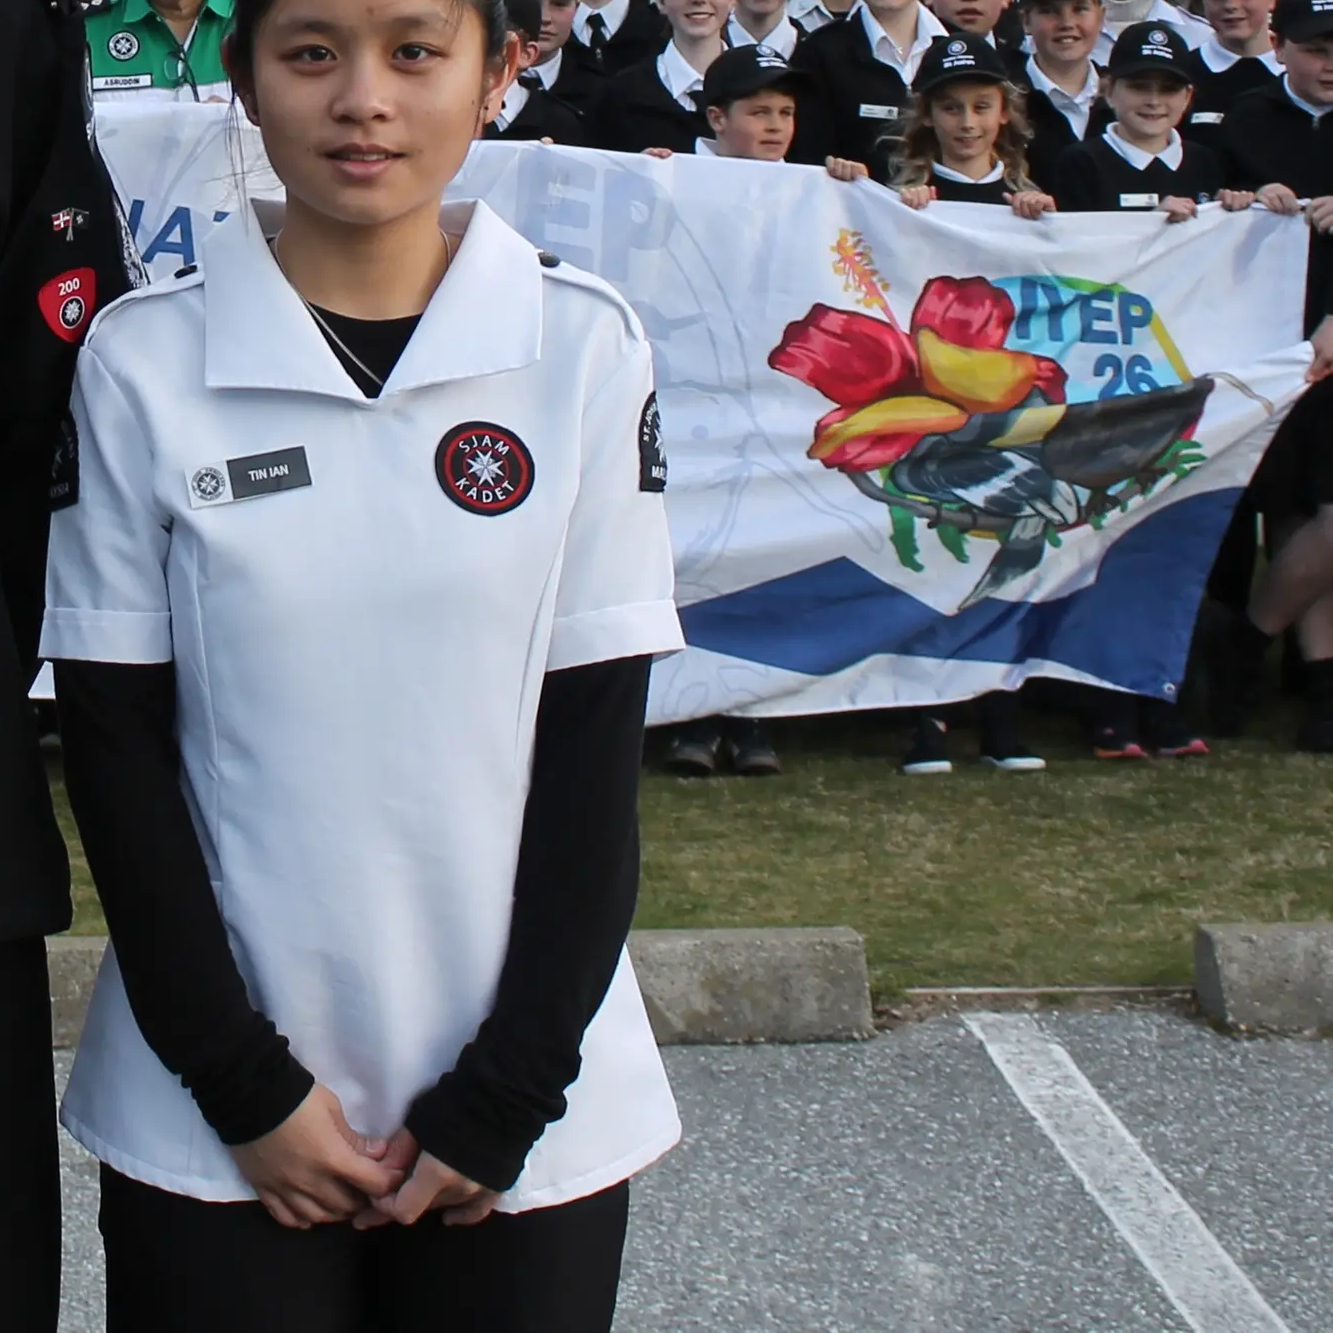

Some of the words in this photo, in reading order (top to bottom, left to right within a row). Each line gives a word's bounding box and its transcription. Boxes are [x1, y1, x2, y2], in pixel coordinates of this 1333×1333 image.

[482, 145, 677, 283] EP
[58, 277, 80, 296] 200
[1092, 352, 1160, 400] 26
[458, 435, 510, 455] SJAM
[248, 468, 268, 482] TIN
[269, 464, 289, 478] IAN
[455, 477, 514, 503] KADET
